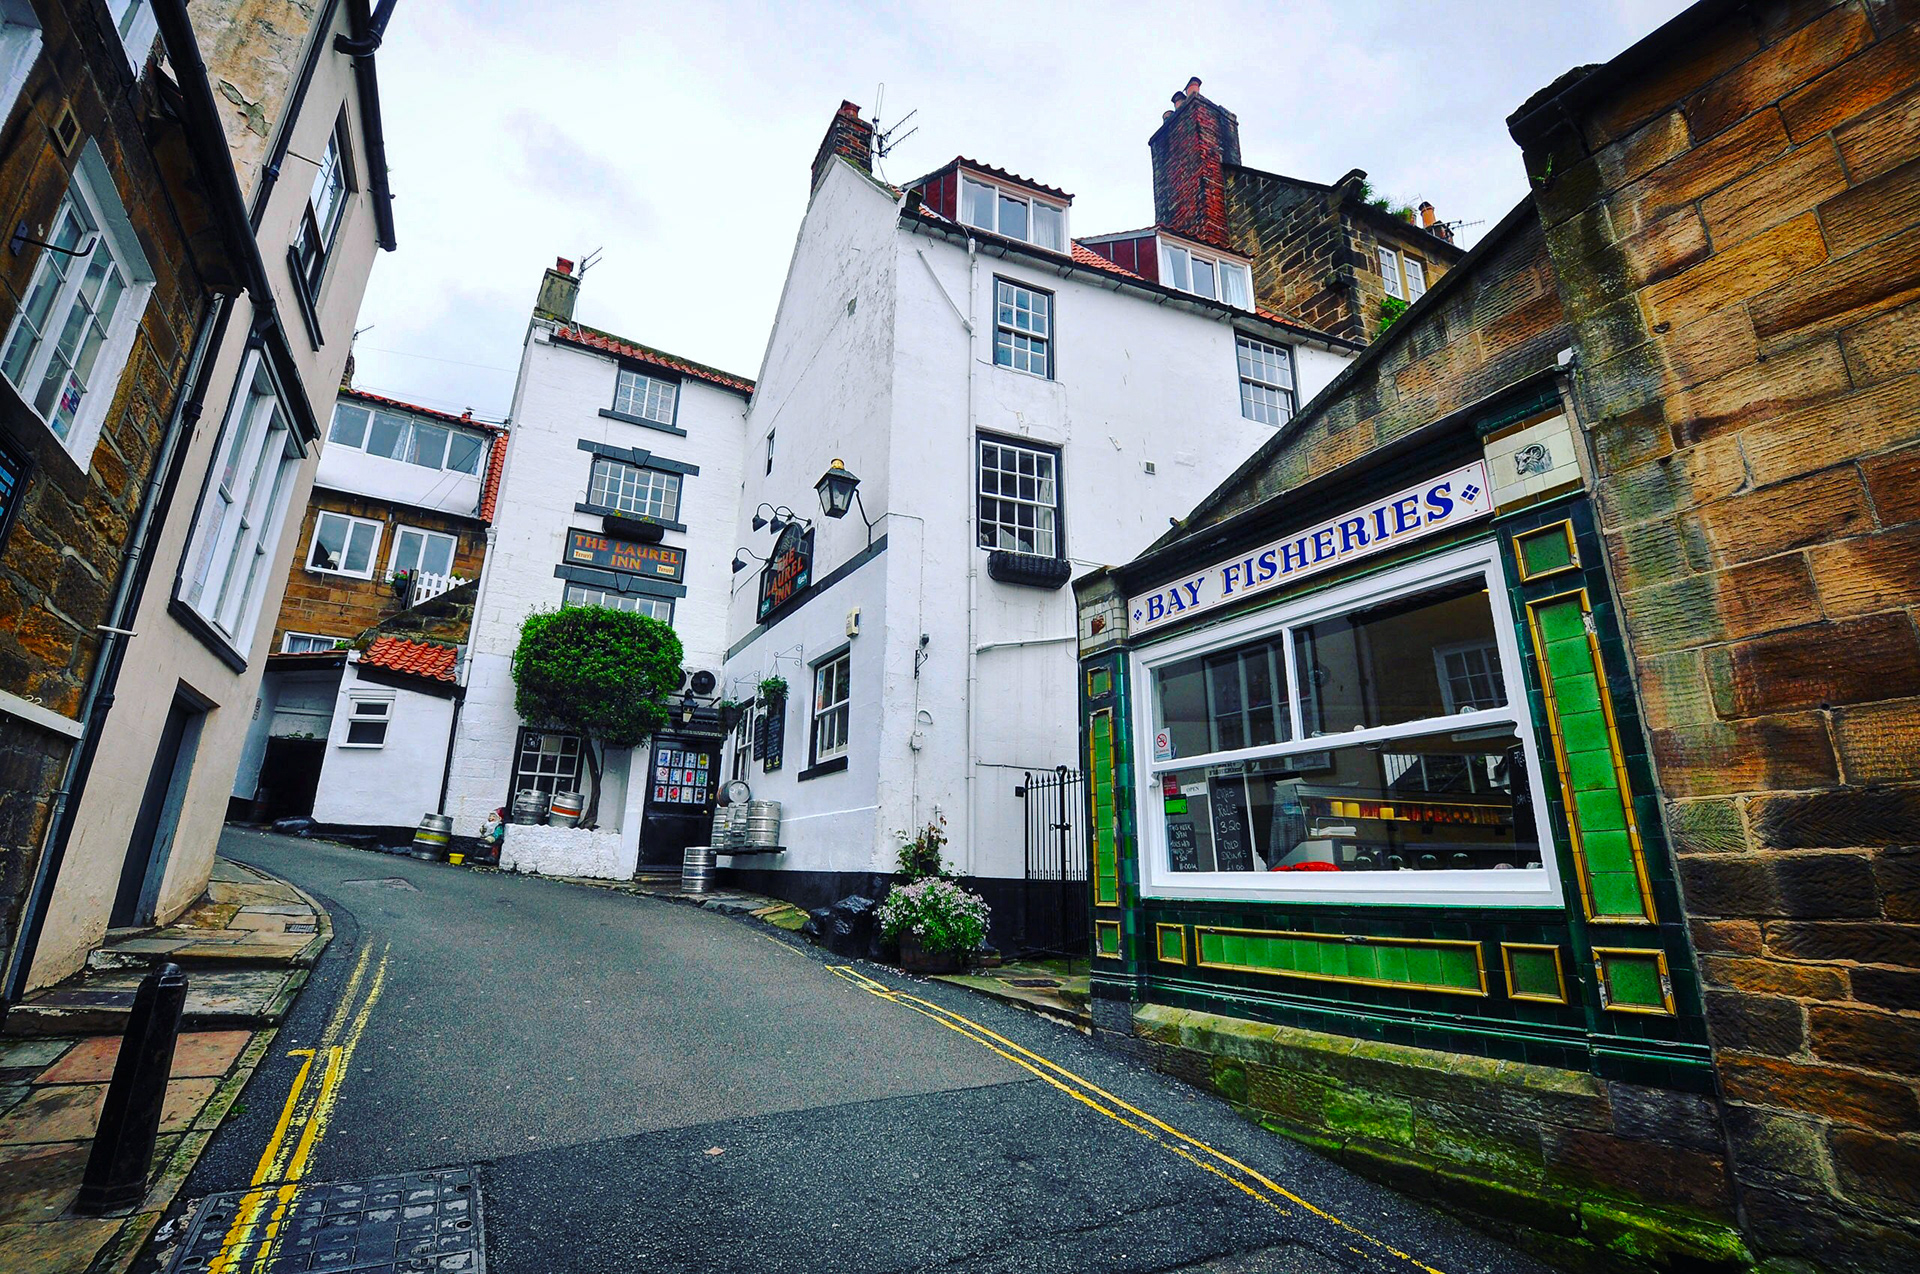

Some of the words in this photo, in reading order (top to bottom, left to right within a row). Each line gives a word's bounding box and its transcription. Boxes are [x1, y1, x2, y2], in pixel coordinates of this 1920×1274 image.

[575, 535, 608, 551] THE
[614, 541, 679, 564] LAUREL
[610, 554, 641, 570] INN
[777, 547, 796, 573] THE
[1146, 577, 1205, 625] BAY
[1221, 481, 1456, 598] FISHERIES
[767, 557, 803, 597] LAUREL
[774, 580, 792, 606] INN
